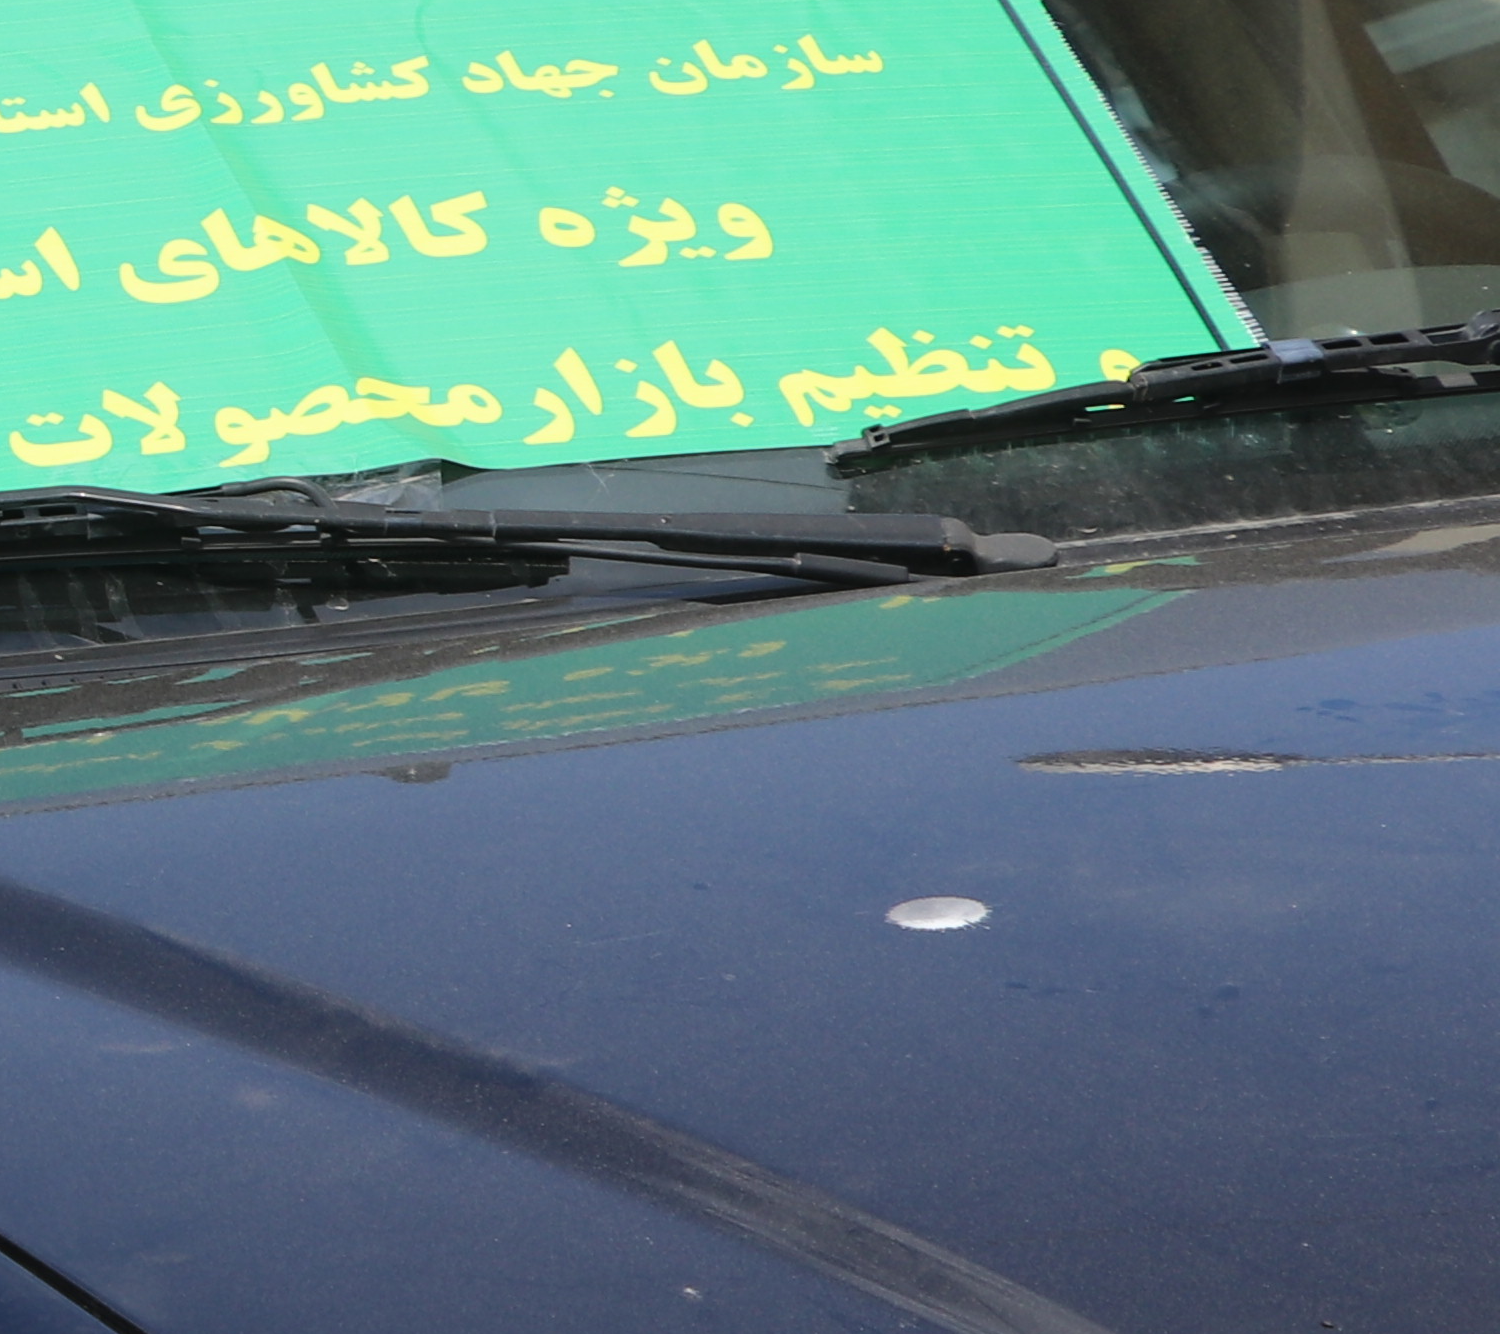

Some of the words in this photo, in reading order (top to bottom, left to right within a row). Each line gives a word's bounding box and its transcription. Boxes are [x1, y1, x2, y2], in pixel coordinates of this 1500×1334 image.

[135, 56, 430, 132] کشاورزی
[463, 51, 619, 99] جهاد
[648, 33, 884, 97] سازمان
[119, 191, 488, 304] کالاهای
[539, 186, 773, 268] ویژه
[9, 372, 503, 468] محصولات
[523, 340, 744, 445] بازار
[779, 325, 1056, 427] تنظیم
